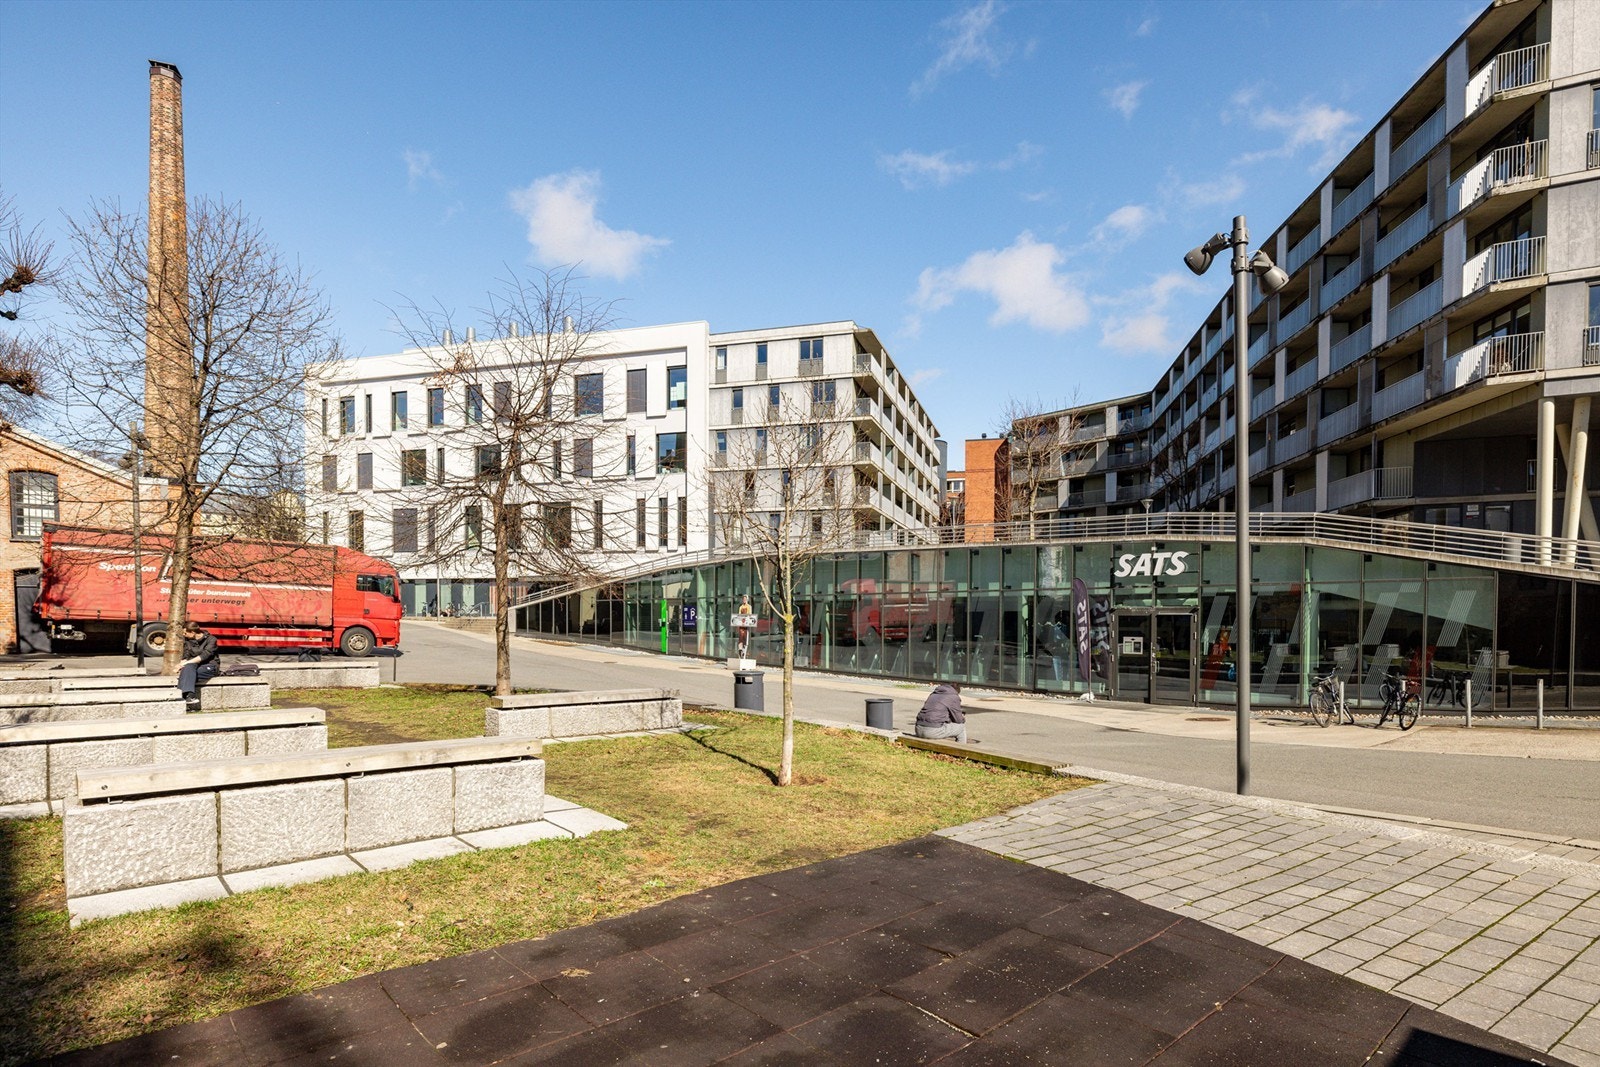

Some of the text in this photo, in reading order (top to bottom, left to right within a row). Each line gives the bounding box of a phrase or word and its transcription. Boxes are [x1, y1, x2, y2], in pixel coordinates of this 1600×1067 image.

[1114, 551, 1189, 577] SATS
[206, 589, 251, 598] bundesweit
[201, 597, 246, 606] unterwegs
